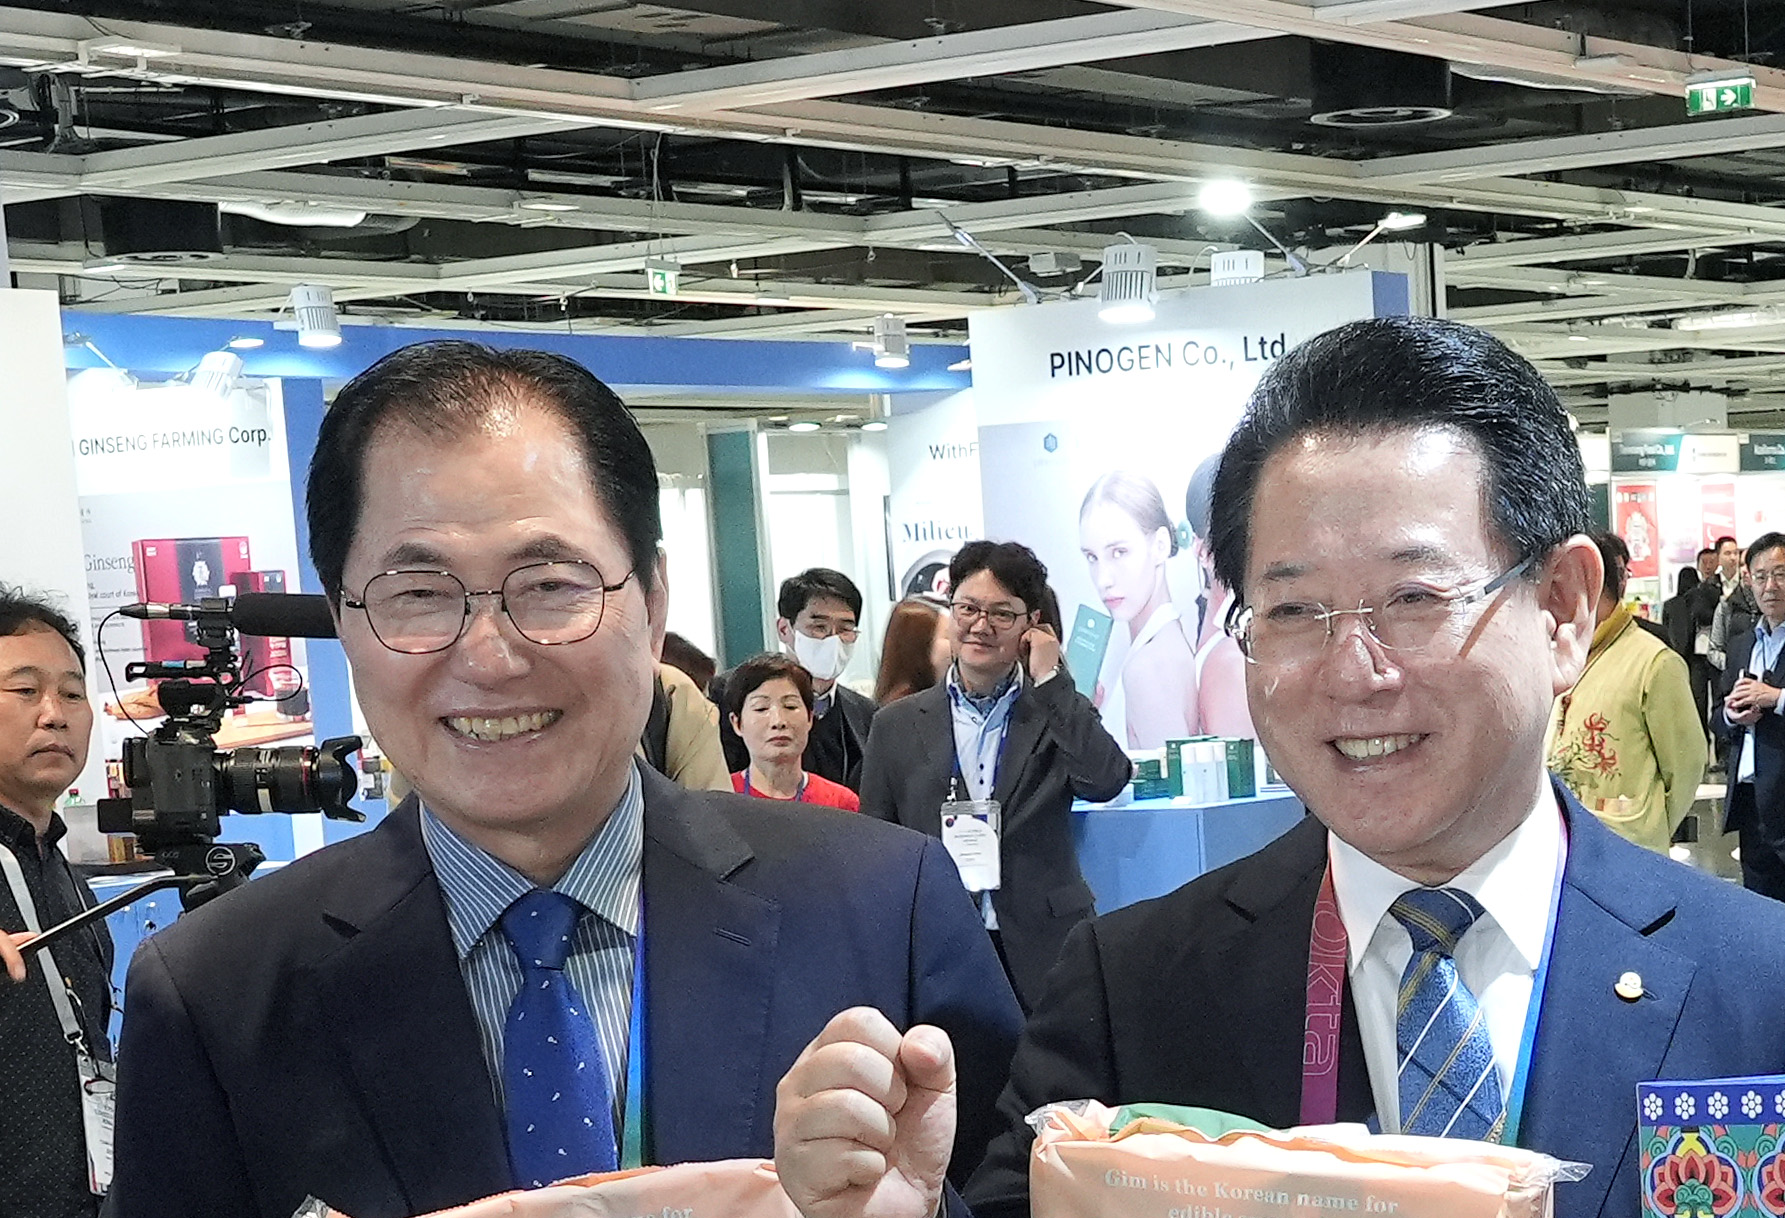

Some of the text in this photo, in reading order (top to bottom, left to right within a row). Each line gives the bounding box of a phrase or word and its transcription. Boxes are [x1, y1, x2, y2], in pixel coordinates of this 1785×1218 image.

[1050, 343, 1172, 377] PINOGEN
[79, 427, 271, 456] GINSENG FARMING Corp.
[1105, 1169, 1398, 1214] Gim is the Korean name for
